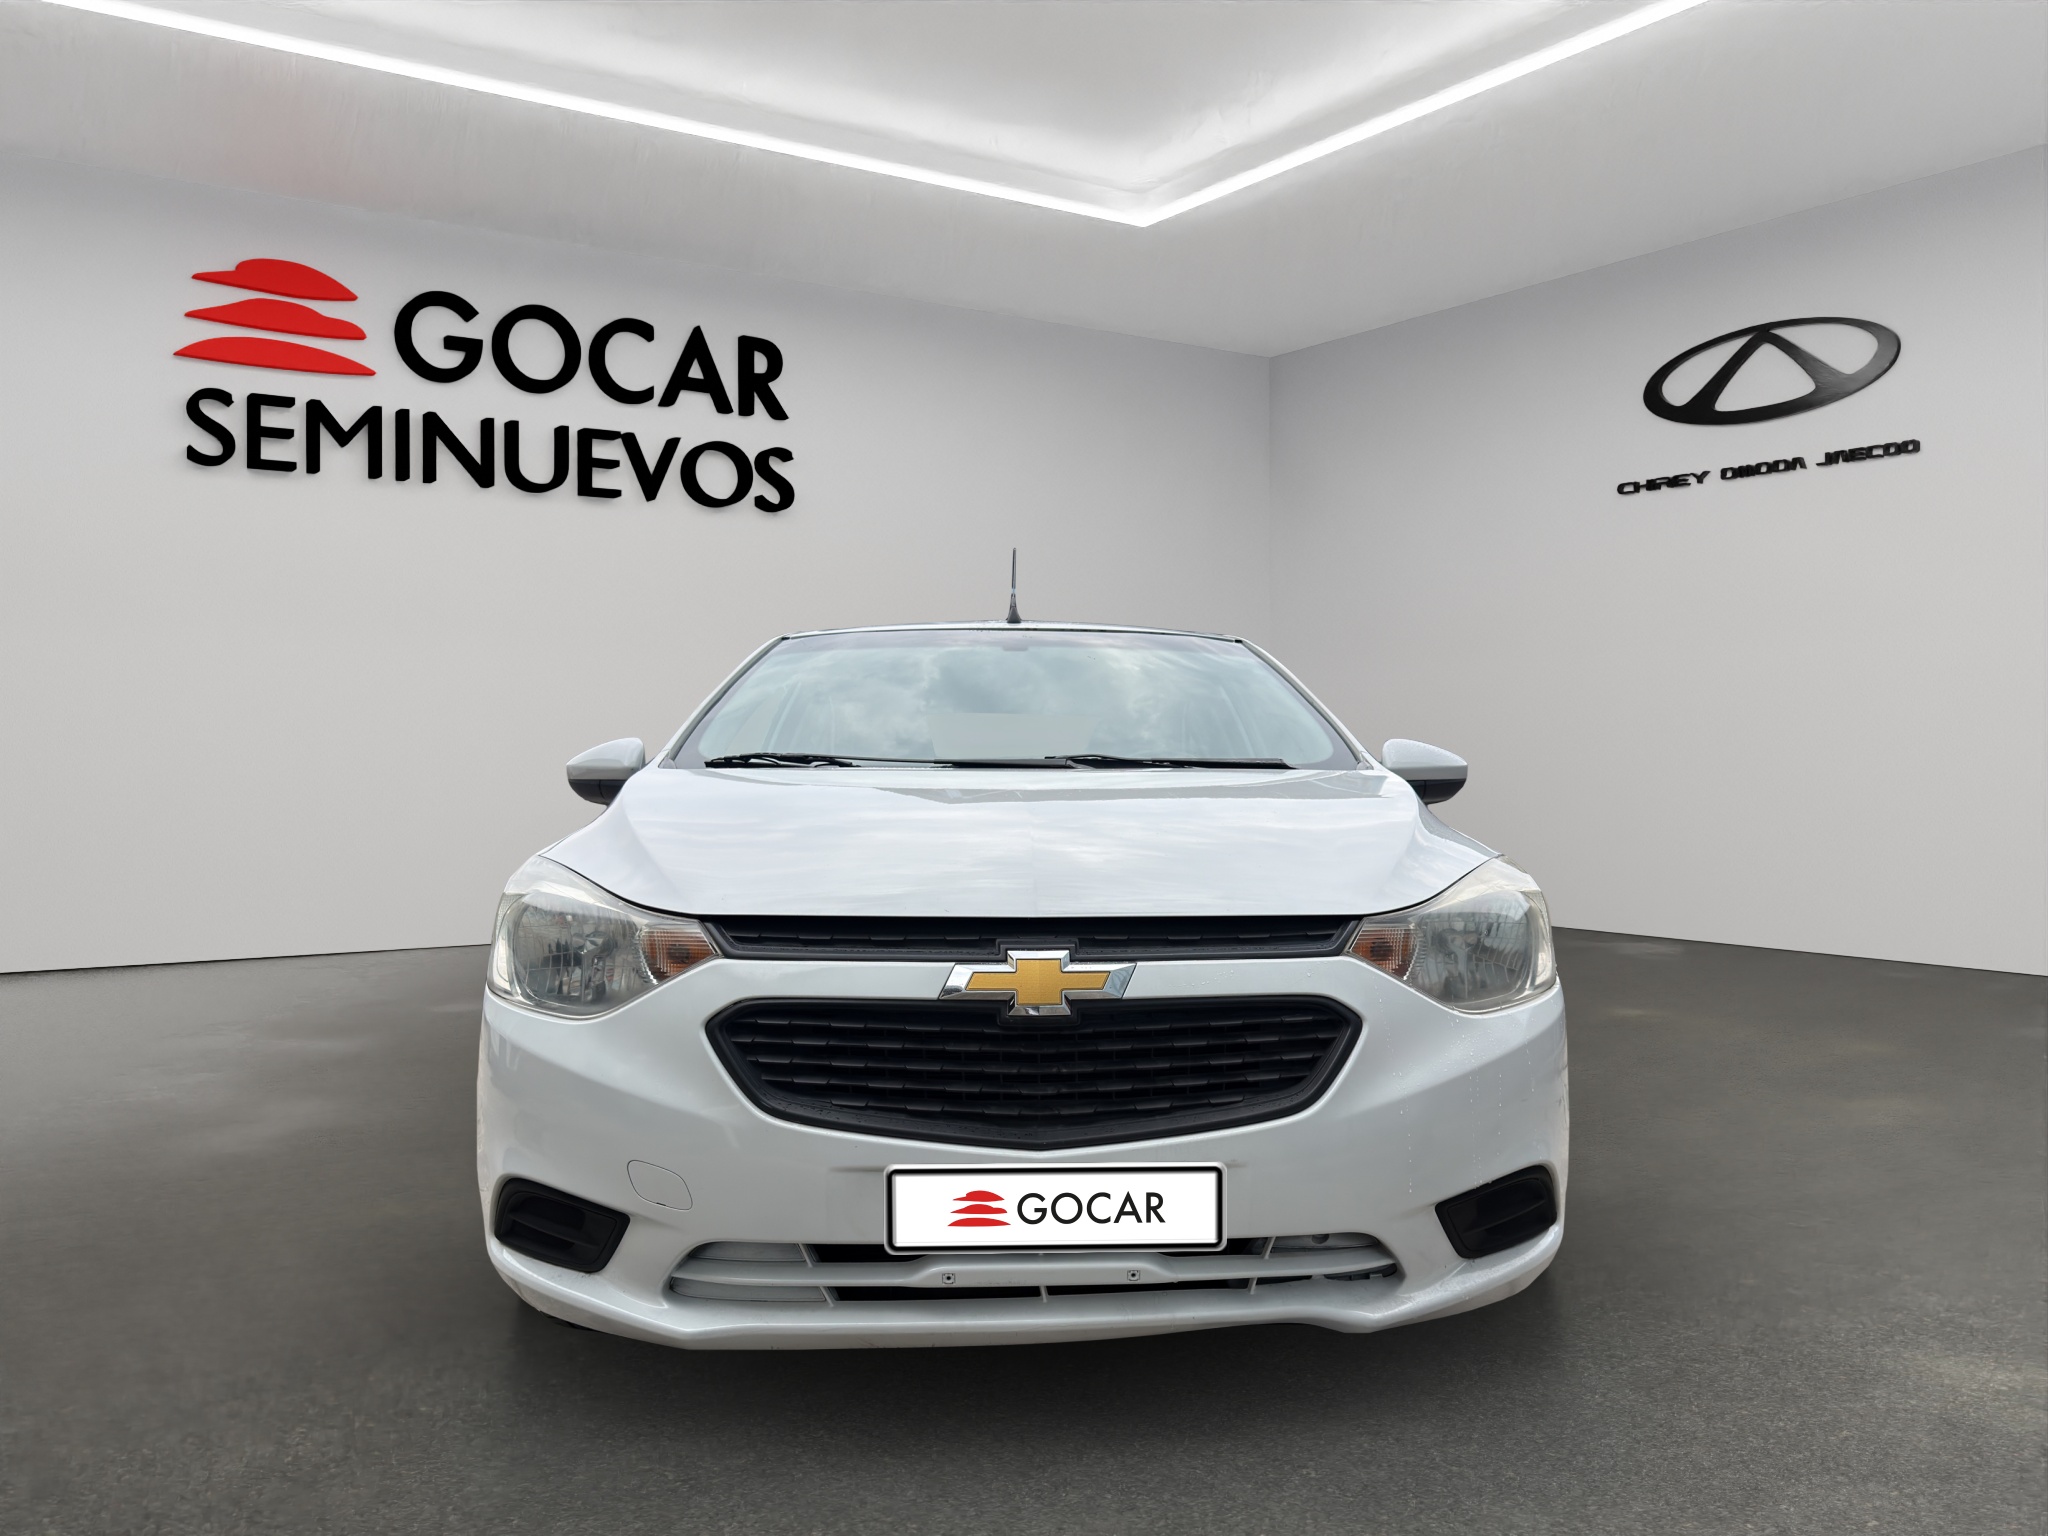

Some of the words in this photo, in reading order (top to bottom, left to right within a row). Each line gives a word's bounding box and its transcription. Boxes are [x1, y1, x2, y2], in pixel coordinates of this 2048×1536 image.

[393, 290, 790, 422] GOCAR
[185, 387, 796, 514] SEMINUEVOS
[1016, 1190, 1167, 1226] GOCAR
